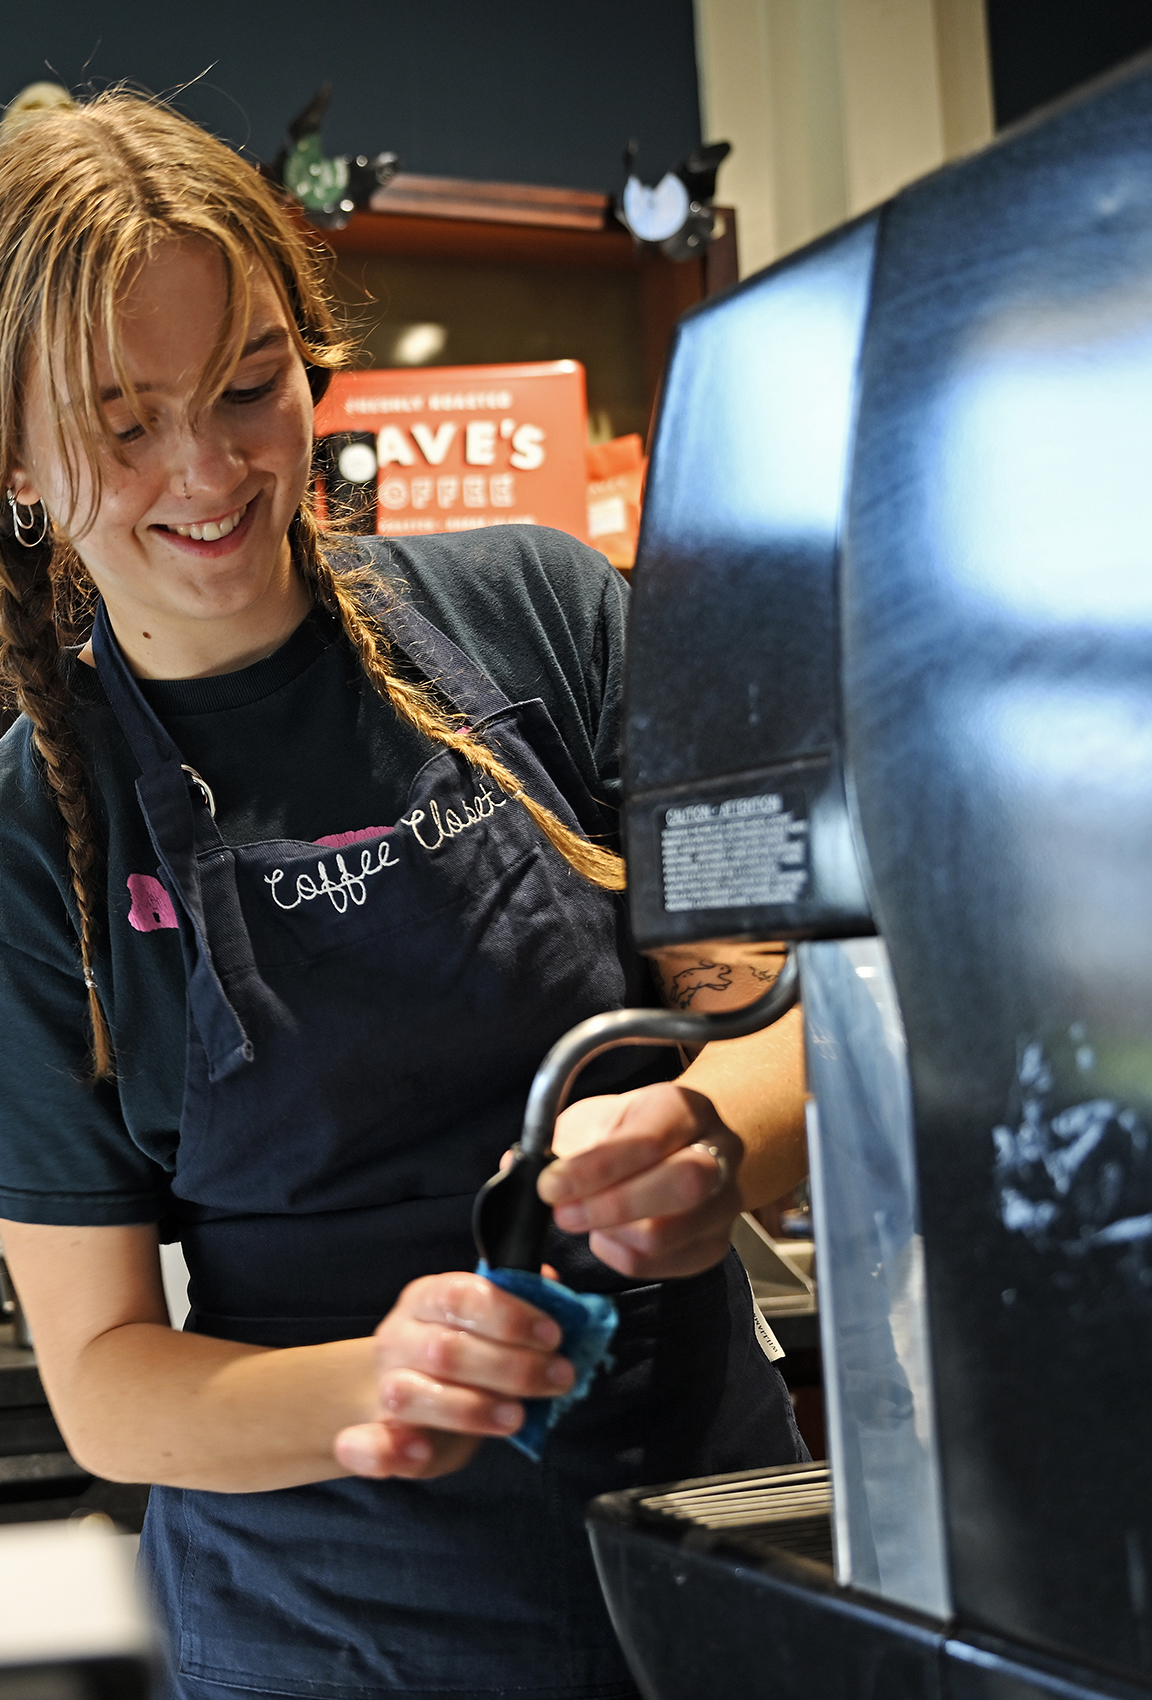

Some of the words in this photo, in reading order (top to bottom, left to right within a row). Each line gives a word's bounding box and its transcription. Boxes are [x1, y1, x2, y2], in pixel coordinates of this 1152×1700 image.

[377, 417, 546, 471] AVE'S
[378, 473, 517, 510] OFFEE
[264, 841, 399, 913] Coffee
[400, 783, 507, 850] Closet
